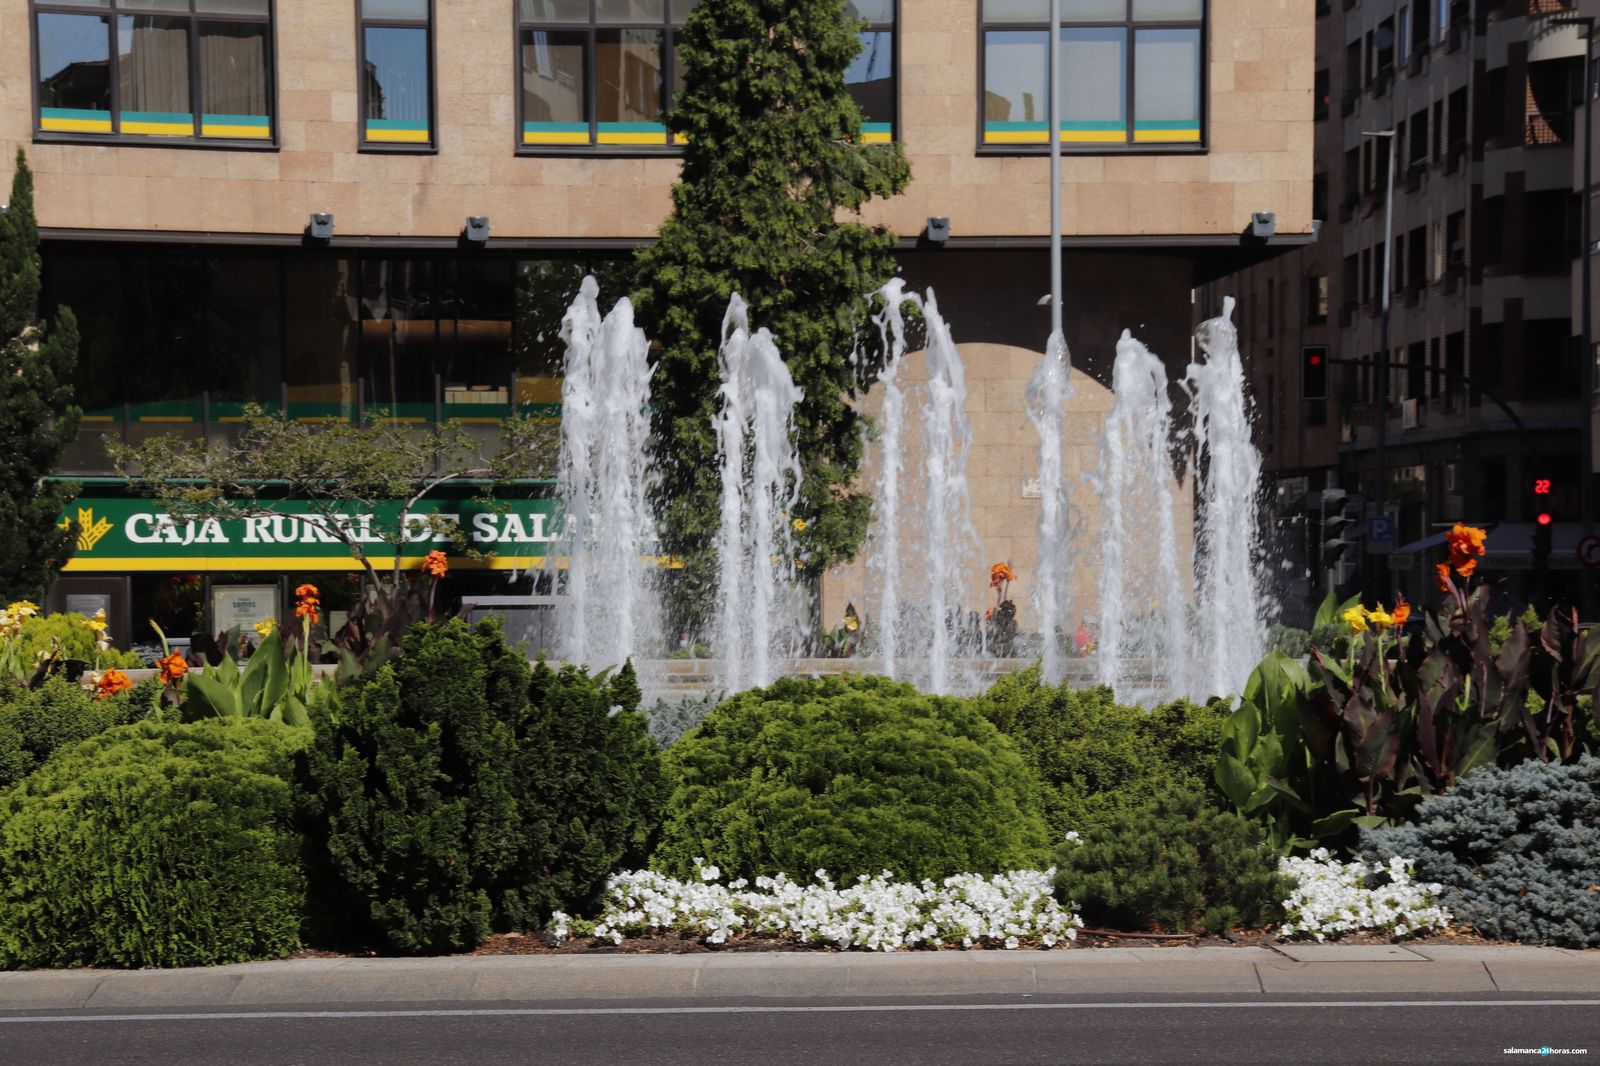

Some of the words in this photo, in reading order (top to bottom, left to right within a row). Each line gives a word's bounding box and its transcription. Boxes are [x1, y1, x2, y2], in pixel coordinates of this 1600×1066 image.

[1535, 479, 1550, 494] 22
[124, 511, 229, 546] CAJA
[242, 511, 387, 544] RURAL
[399, 511, 460, 544] DE
[1373, 520, 1388, 539] P
